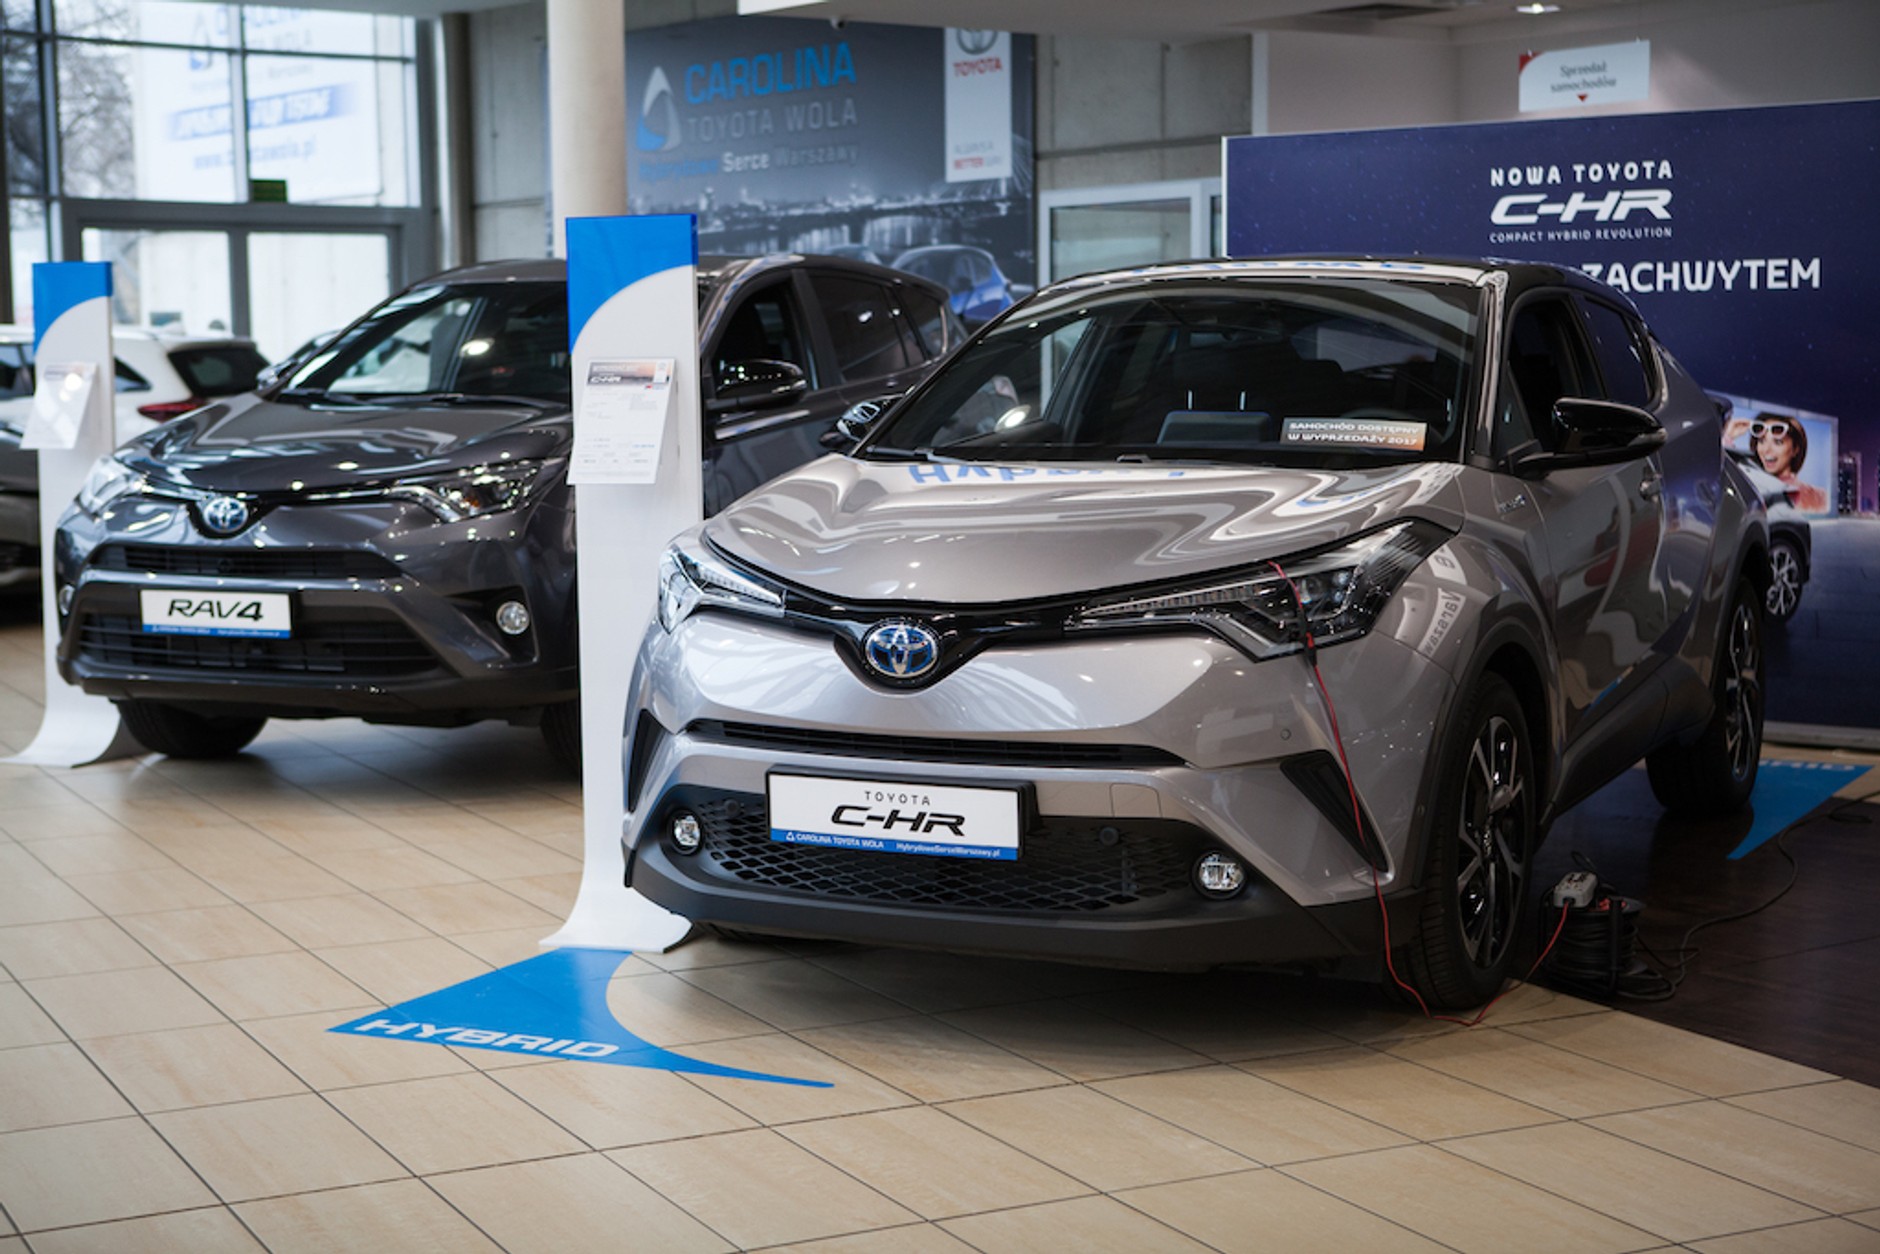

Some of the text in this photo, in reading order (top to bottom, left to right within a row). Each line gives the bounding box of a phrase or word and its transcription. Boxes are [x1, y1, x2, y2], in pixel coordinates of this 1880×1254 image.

[685, 41, 857, 104] CAROLINA
[953, 57, 1002, 77] TOYOTA
[687, 98, 858, 142] TOYOTA WOLA
[722, 151, 770, 173] Serce
[1490, 160, 1673, 187] NOWA TOYOTA
[1490, 189, 1673, 225] C-HR
[1489, 227, 1673, 244] COMPACT HYBRID REVOLUTION
[1289, 421, 1355, 431] SAMOCHÓD
[1287, 433, 1299, 441] W
[1387, 436, 1417, 446] 2017
[168, 599, 263, 621] RAV4
[864, 790, 931, 806] TOYOTA
[831, 804, 965, 837] C-HR
[796, 833, 832, 844] CAROLINA
[833, 836, 860, 847] TOYOTA
[861, 839, 884, 849] WOLA
[354, 1018, 620, 1058] HYBRID
